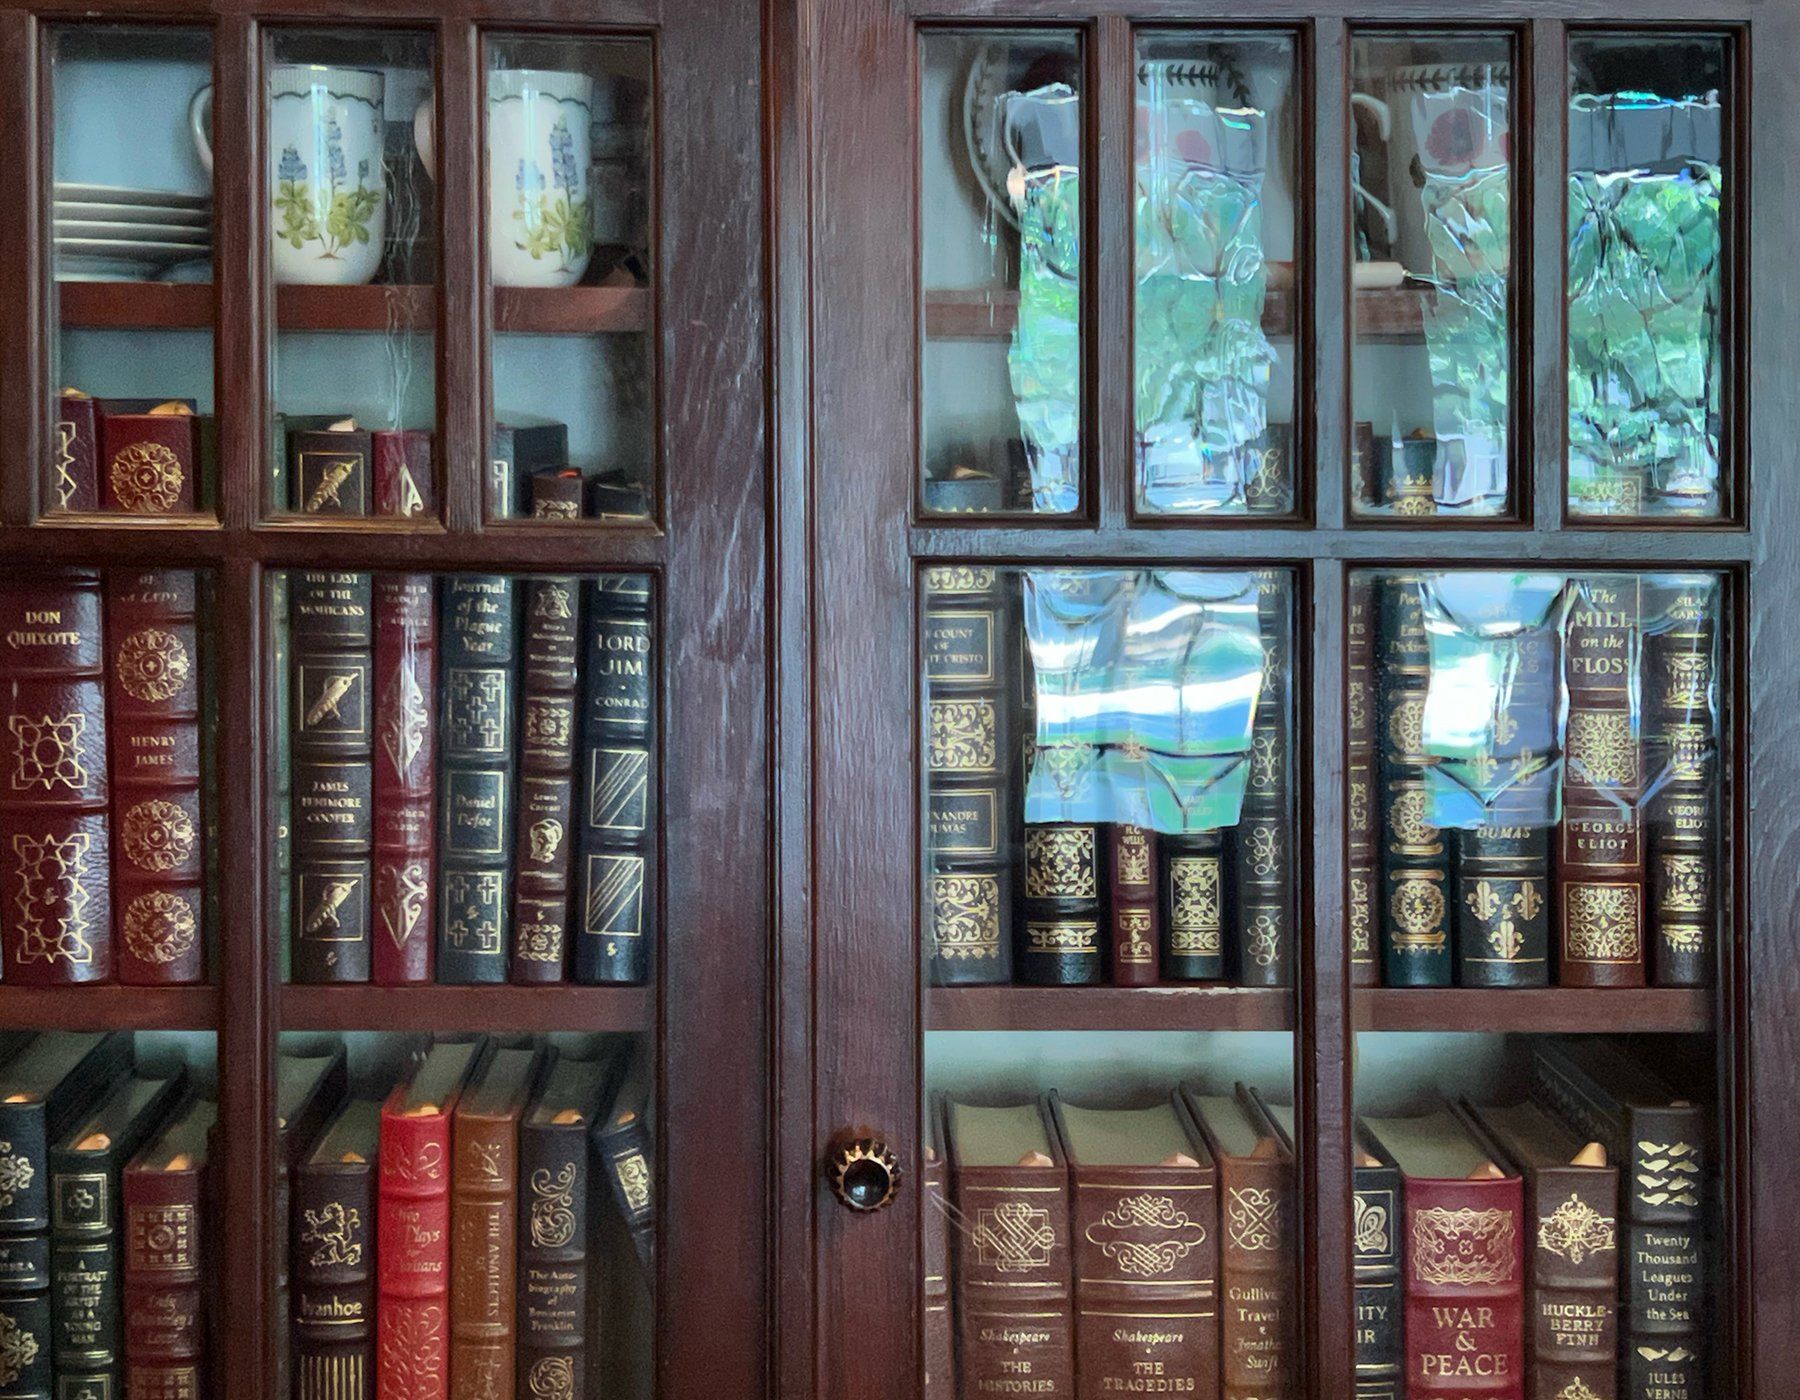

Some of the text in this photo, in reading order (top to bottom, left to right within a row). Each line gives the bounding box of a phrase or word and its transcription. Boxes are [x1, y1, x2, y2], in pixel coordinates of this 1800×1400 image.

[1590, 589, 1617, 603] The
[477, 598, 499, 613] the
[26, 611, 60, 624] DON
[1575, 610, 1633, 628] MILL
[7, 630, 81, 650] QUIXOTE
[934, 629, 973, 639] COUNT
[1581, 634, 1625, 648] on the
[598, 633, 651, 653] LORD
[944, 654, 984, 663] CRISTO
[600, 659, 643, 676] JIM
[595, 697, 650, 709] CONRAD
[131, 736, 176, 747] HENRY
[135, 754, 174, 767] JAMES
[313, 781, 349, 792] JAMES
[1476, 826, 1531, 839] DUMAS
[1570, 822, 1635, 834] GEORGE
[1577, 838, 1628, 849] ELIOT
[1644, 1233, 1690, 1250] Twenty
[1636, 1252, 1697, 1265] Thousand
[1642, 1270, 1693, 1287] Leagues
[1648, 1288, 1688, 1301] Under
[301, 1293, 363, 1316] Ivanhoe
[1543, 1303, 1613, 1318] HUCKLE-
[1432, 1307, 1495, 1329] WAR
[1646, 1307, 1690, 1320] the Sea
[1550, 1318, 1604, 1332] BERRY
[979, 1329, 1050, 1345] Shakespeare
[1113, 1328, 1184, 1345] Shakespeare
[1455, 1330, 1478, 1352] &
[1001, 1361, 1032, 1374] THE
[1133, 1361, 1165, 1375] THE
[1421, 1353, 1509, 1377] PEACE
[1103, 1378, 1195, 1392] TRAGEDIES
[1648, 1372, 1686, 1385] JULES
[978, 1380, 1055, 1393] HISTORIES
[1645, 1387, 1688, 1400] VERNE
